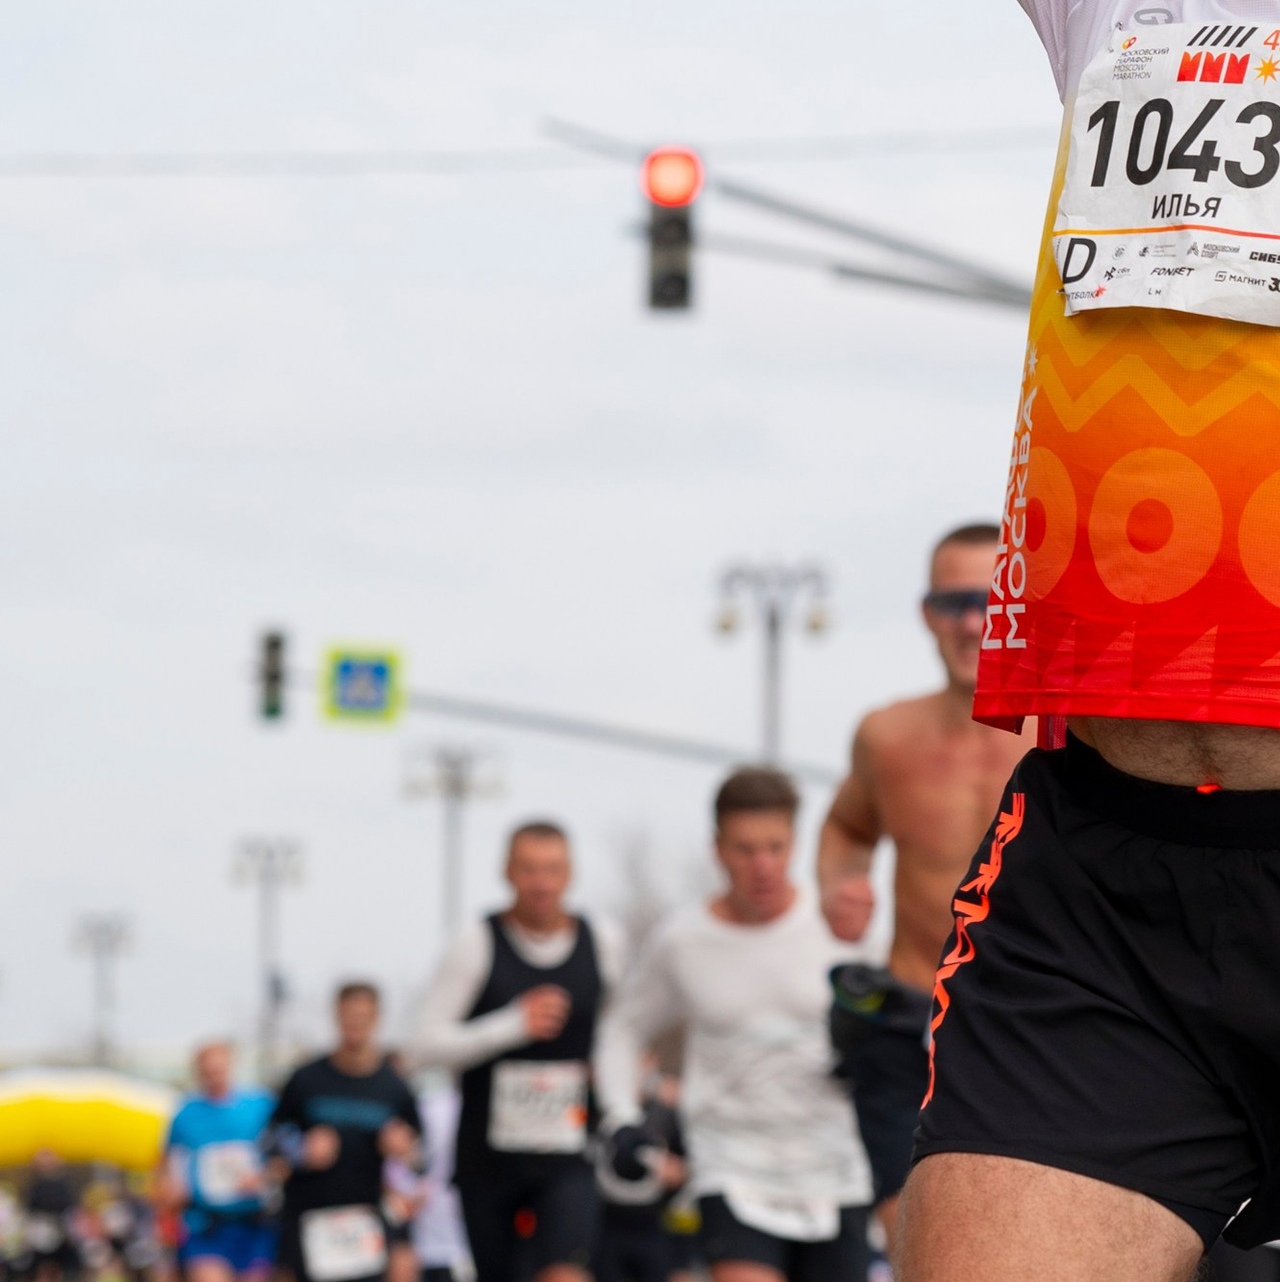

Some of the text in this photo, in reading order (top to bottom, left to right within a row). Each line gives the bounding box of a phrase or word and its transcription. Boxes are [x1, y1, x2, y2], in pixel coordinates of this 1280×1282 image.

[1152, 194, 1222, 220] ИЛЬЯ
[1062, 237, 1097, 284] D
[1229, 274, 1267, 287] МАГНИТ
[1006, 385, 1037, 649] МОСКВА
